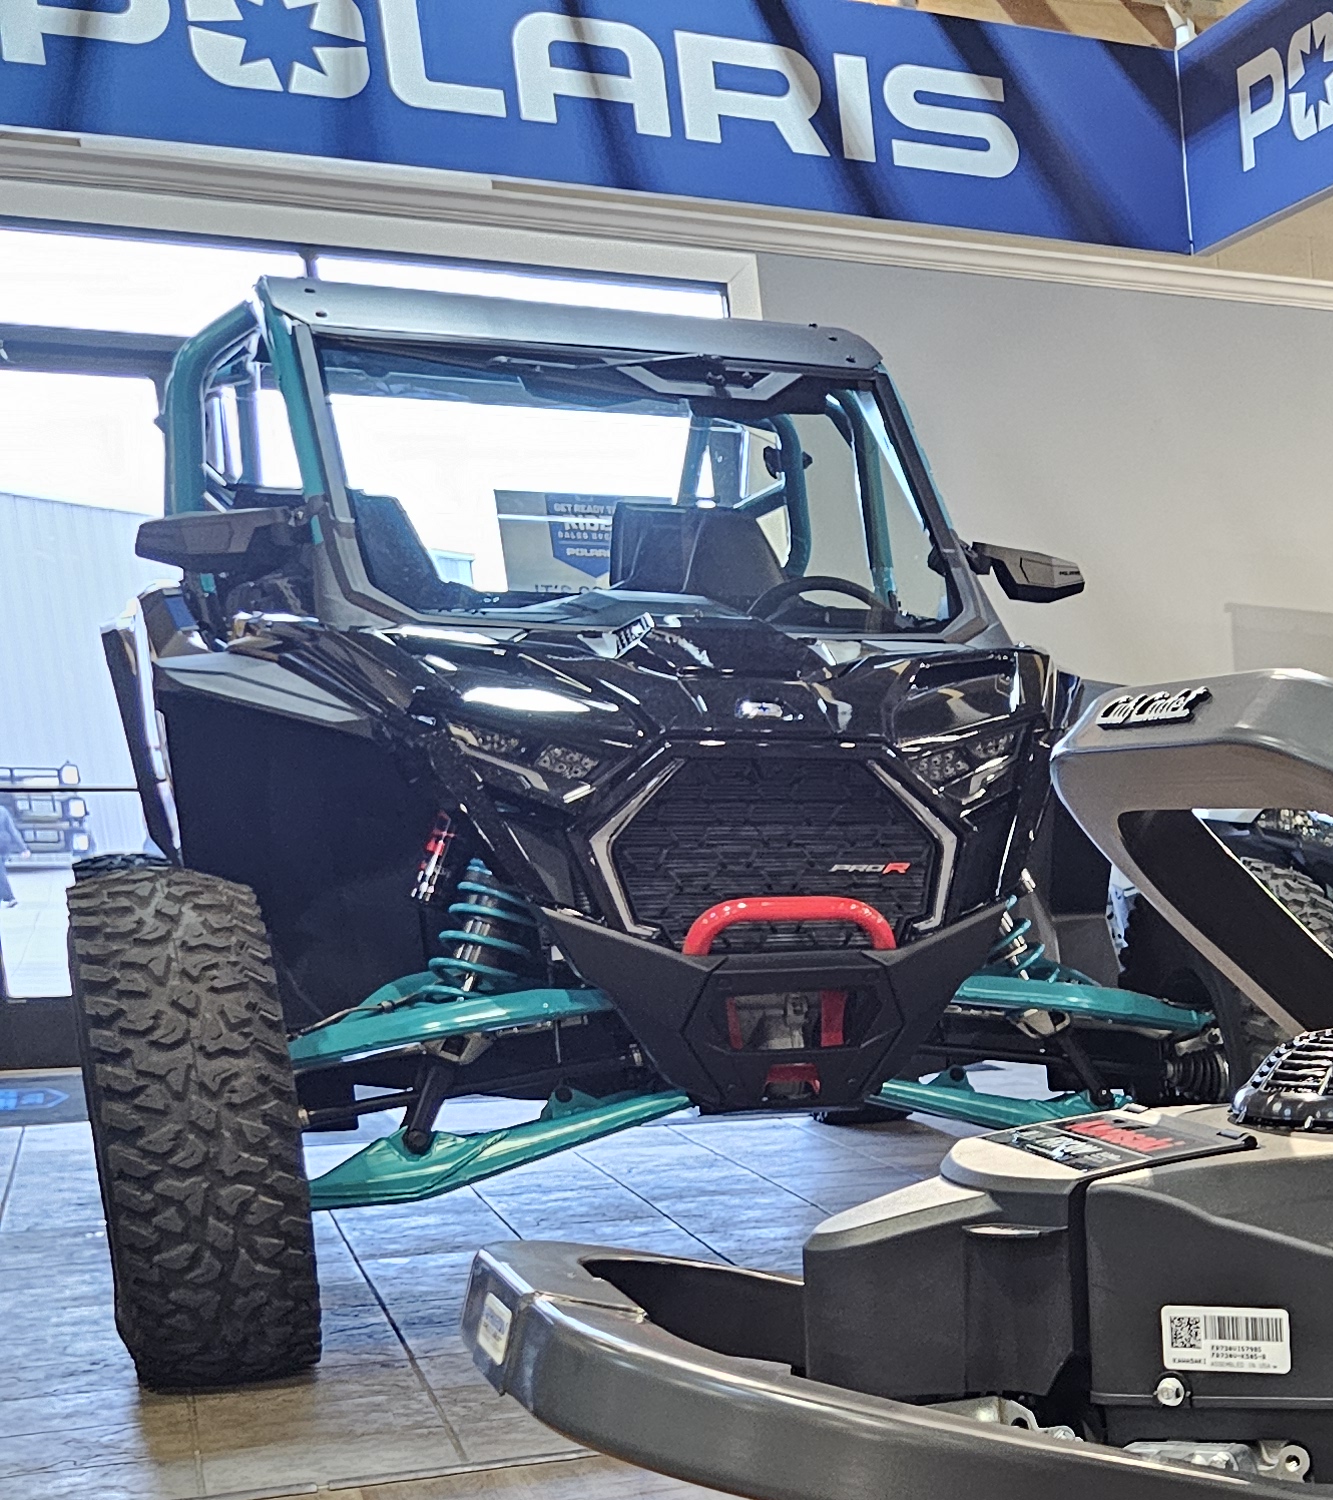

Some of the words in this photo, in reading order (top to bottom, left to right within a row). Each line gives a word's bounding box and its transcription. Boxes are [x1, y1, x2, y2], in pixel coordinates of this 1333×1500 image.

[0, 0, 1021, 179] POLARIS
[574, 504, 605, 514] READY
[828, 864, 885, 873] PRO
[882, 862, 911, 874] R
